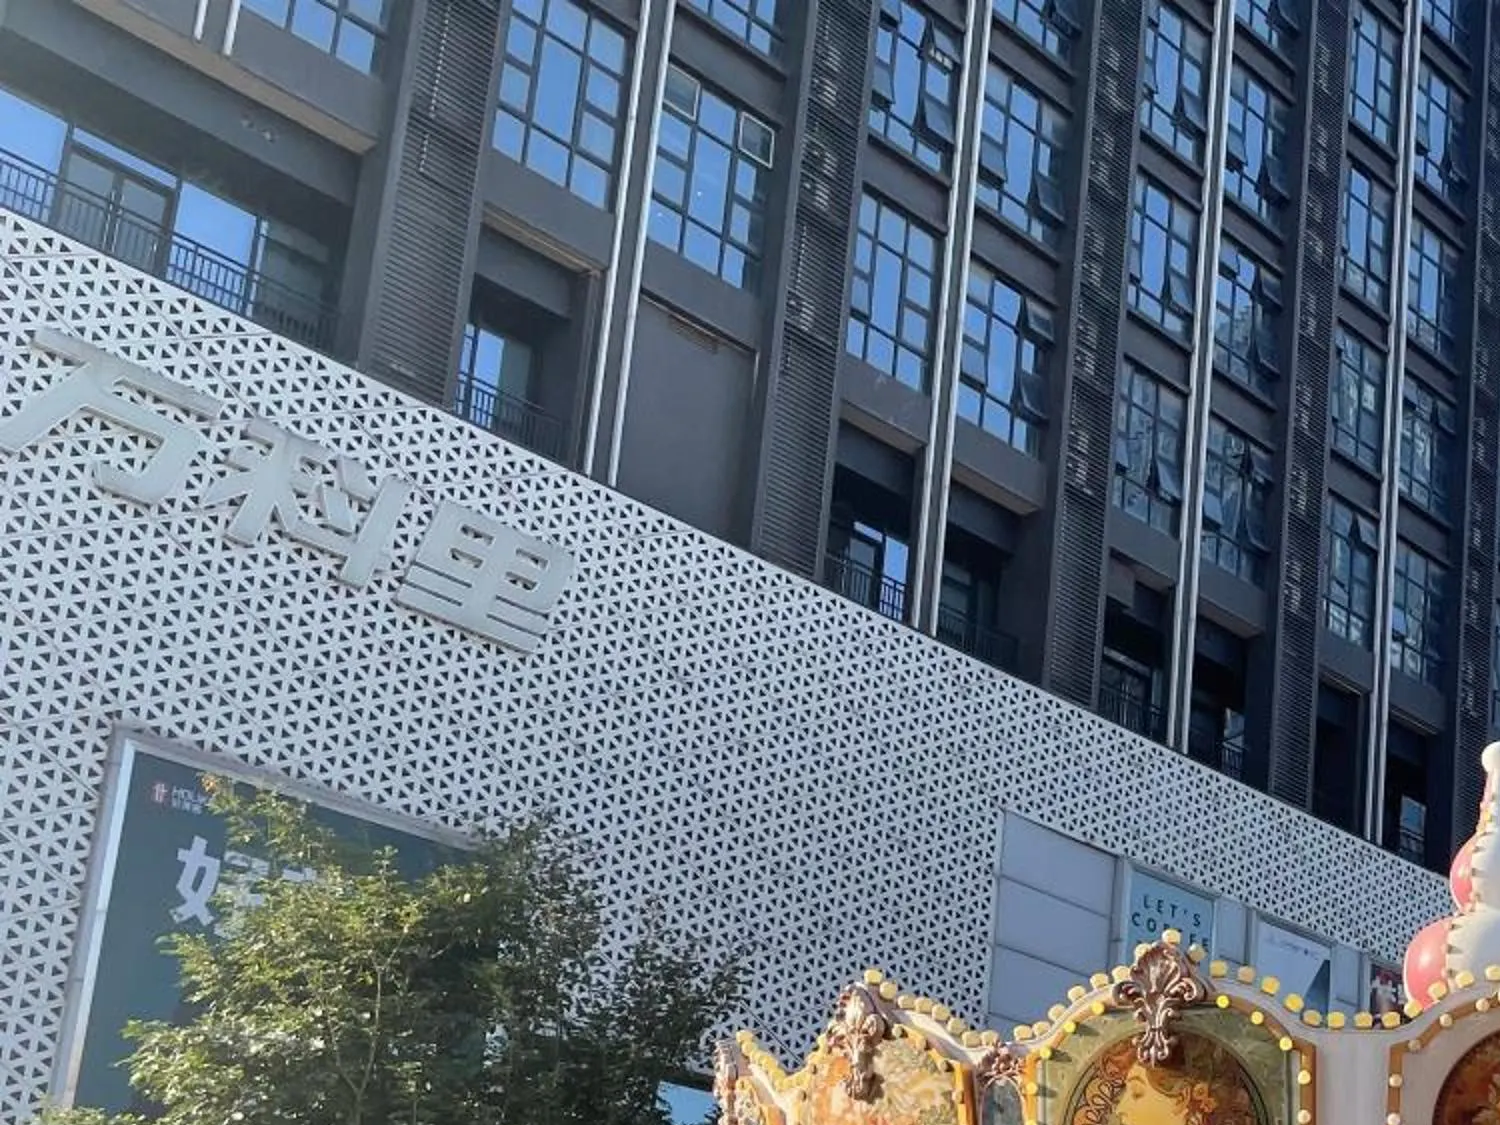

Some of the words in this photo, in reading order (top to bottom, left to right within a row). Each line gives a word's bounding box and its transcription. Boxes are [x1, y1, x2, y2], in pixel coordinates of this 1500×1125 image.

[0, 328, 575, 656] 万科里
[1143, 894, 1201, 927] LET'S
[1131, 911, 1210, 953] COEE
